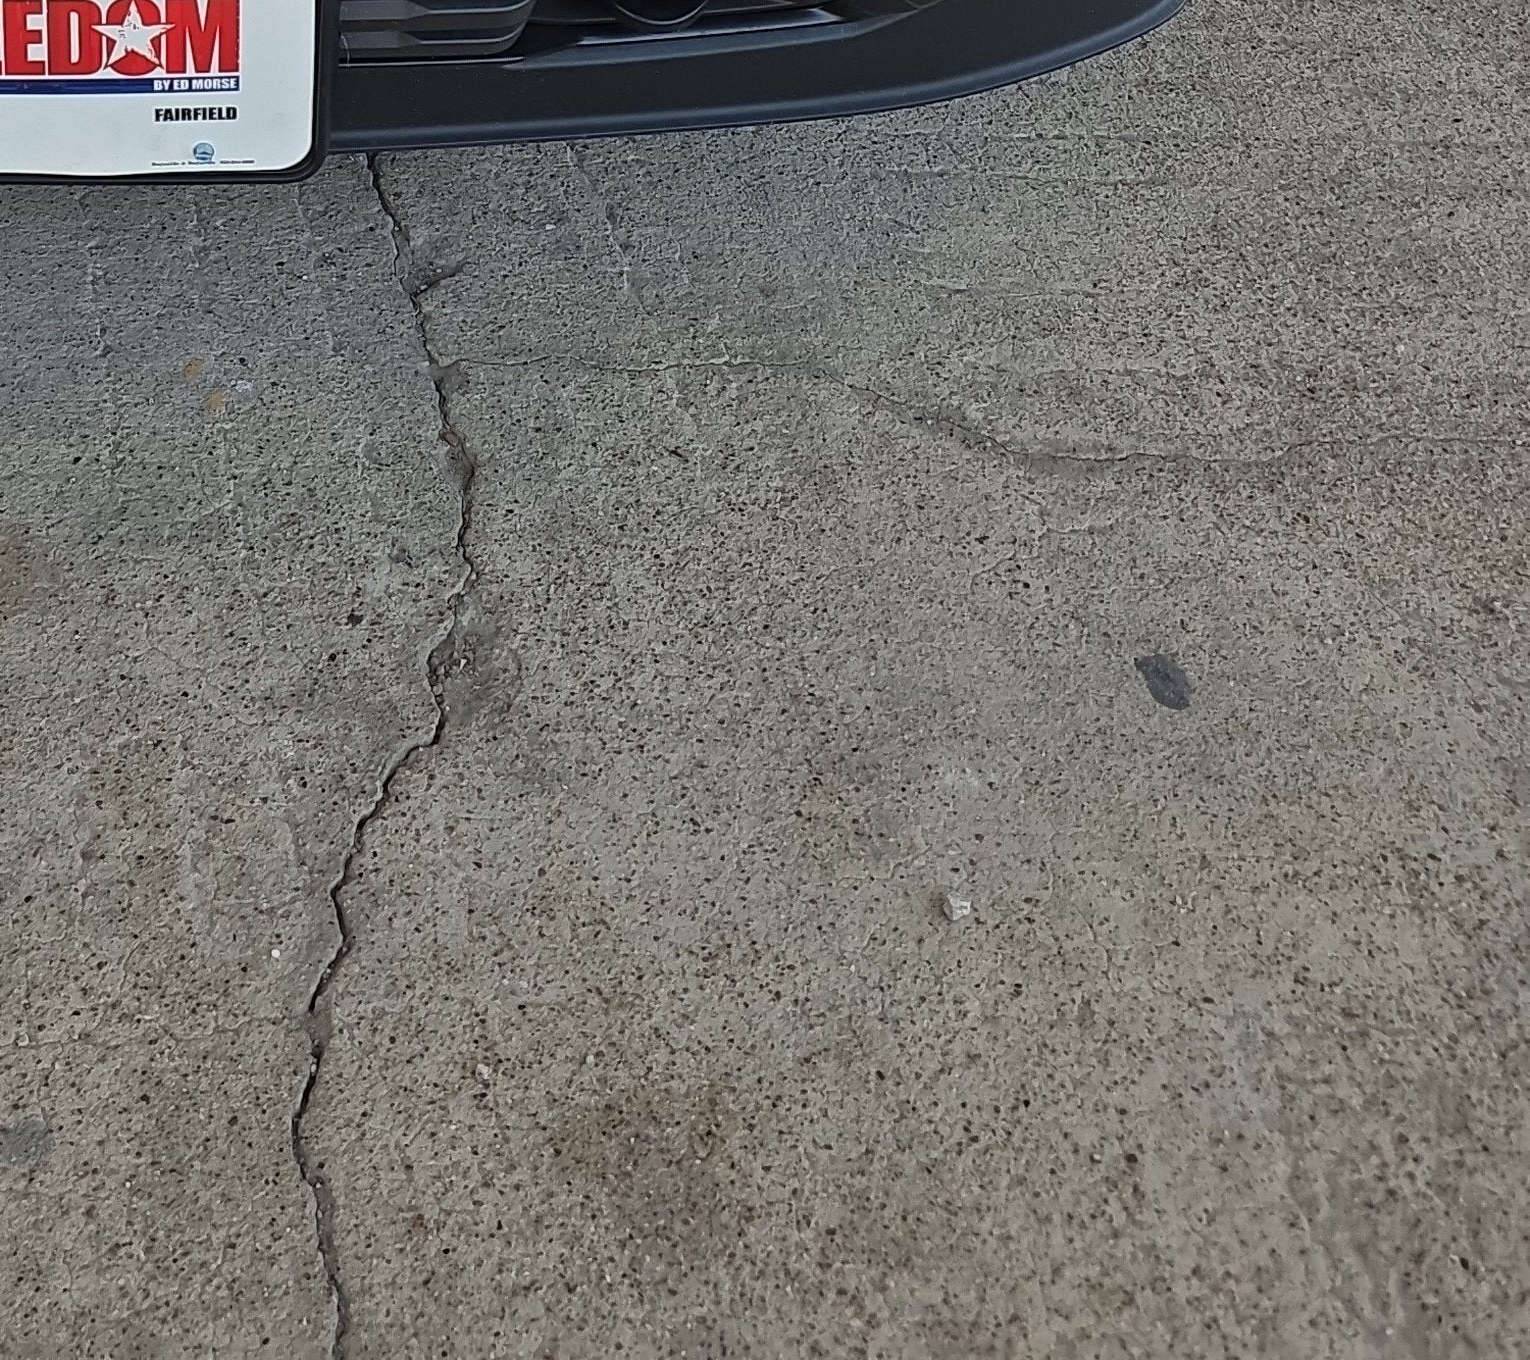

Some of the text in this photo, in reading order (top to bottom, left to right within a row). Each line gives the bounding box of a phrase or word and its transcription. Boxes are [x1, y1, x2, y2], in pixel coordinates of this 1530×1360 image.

[153, 78, 238, 91] BY ED MORSE
[154, 106, 238, 122] FAIRFIELD
